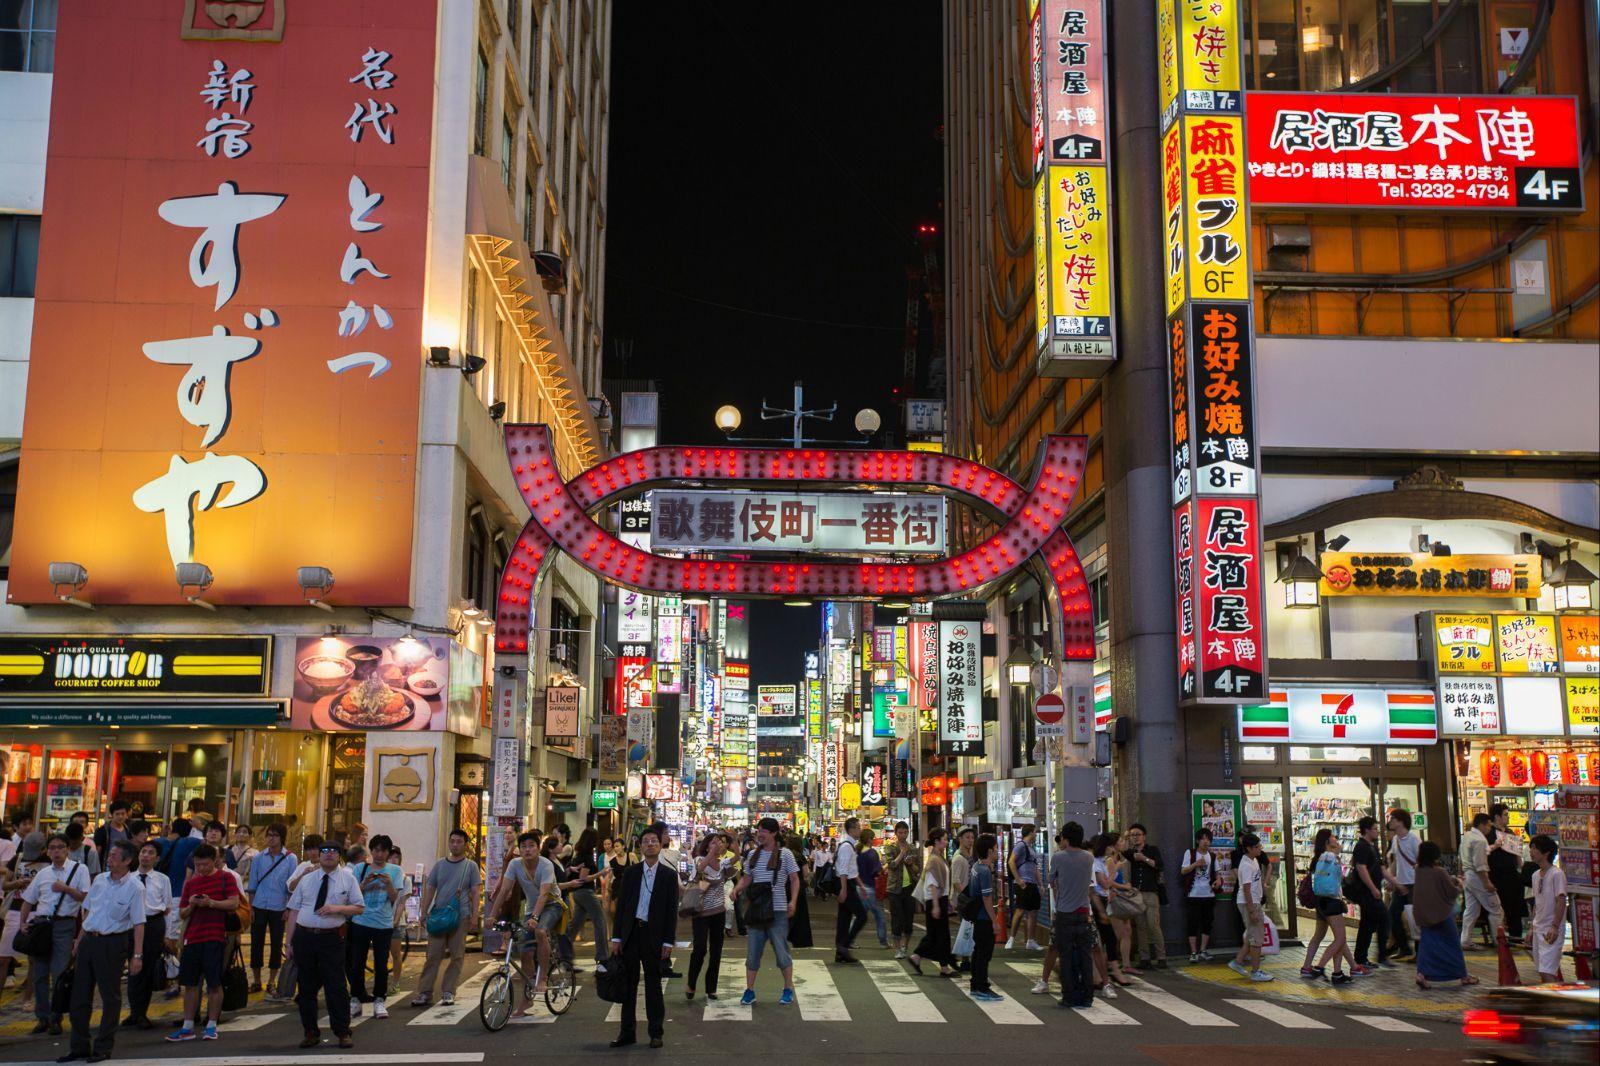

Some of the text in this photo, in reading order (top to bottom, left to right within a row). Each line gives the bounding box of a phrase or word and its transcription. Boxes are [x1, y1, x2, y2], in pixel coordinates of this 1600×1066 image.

[1059, 10, 1089, 95] 居酒屋
[1193, 26, 1227, 83] 焼き
[197, 61, 254, 158] 新宿
[1217, 92, 1235, 110] 7F
[1056, 107, 1097, 127] 本陣
[1059, 138, 1094, 159] 4F
[1190, 119, 1241, 266] 麻雀ブル
[1381, 183, 1510, 200] Tel.3232-4794
[1523, 169, 1570, 200] 4F
[1075, 171, 1102, 222] お好み
[328, 49, 396, 378] 名代 とんかつ
[1061, 178, 1093, 245] もんじゃ
[1056, 217, 1078, 250] たこ
[1064, 253, 1097, 311] 焼き
[1172, 278, 1182, 305] 6F
[1204, 271, 1235, 293] 6F
[1087, 317, 1105, 334] 7F
[1062, 342, 1103, 354] 小松ビル
[132, 180, 290, 570] すずや
[1172, 320, 1188, 445] お好み焼
[1203, 309, 1244, 434] お好み焼
[1175, 443, 1190, 469] 本陣
[1201, 436, 1250, 461] 本陣
[1178, 475, 1188, 496] 8F
[1209, 466, 1243, 488] 8F
[626, 517, 649, 528] 3F
[658, 496, 938, 543] 歌舞伎町一番街
[1179, 513, 1192, 637] 居酒屋
[1204, 507, 1254, 634] 居酒屋
[1438, 616, 1489, 625] 全国チェーンの店
[1501, 616, 1535, 636] お好み
[1452, 627, 1476, 640] 麻雀
[622, 645, 646, 657] 焼肉
[1207, 638, 1256, 662] 本陣
[1450, 646, 1480, 659] ブル
[1501, 647, 1526, 662] たこ
[55, 651, 163, 679] DOUTOR
[1441, 662, 1465, 670] 新宿店
[1481, 662, 1494, 670] 6F
[55, 680, 99, 688] GOURMET
[137, 680, 161, 688] SHOP
[946, 641, 966, 733] お好み焼本陣
[1184, 670, 1194, 693] 4F
[1214, 669, 1250, 693] 4F
[549, 690, 577, 703] Like!
[1444, 694, 1495, 705] お好み焼
[1454, 707, 1479, 718] 本陣
[1464, 721, 1478, 731] 2F
[952, 742, 970, 751] 2F
